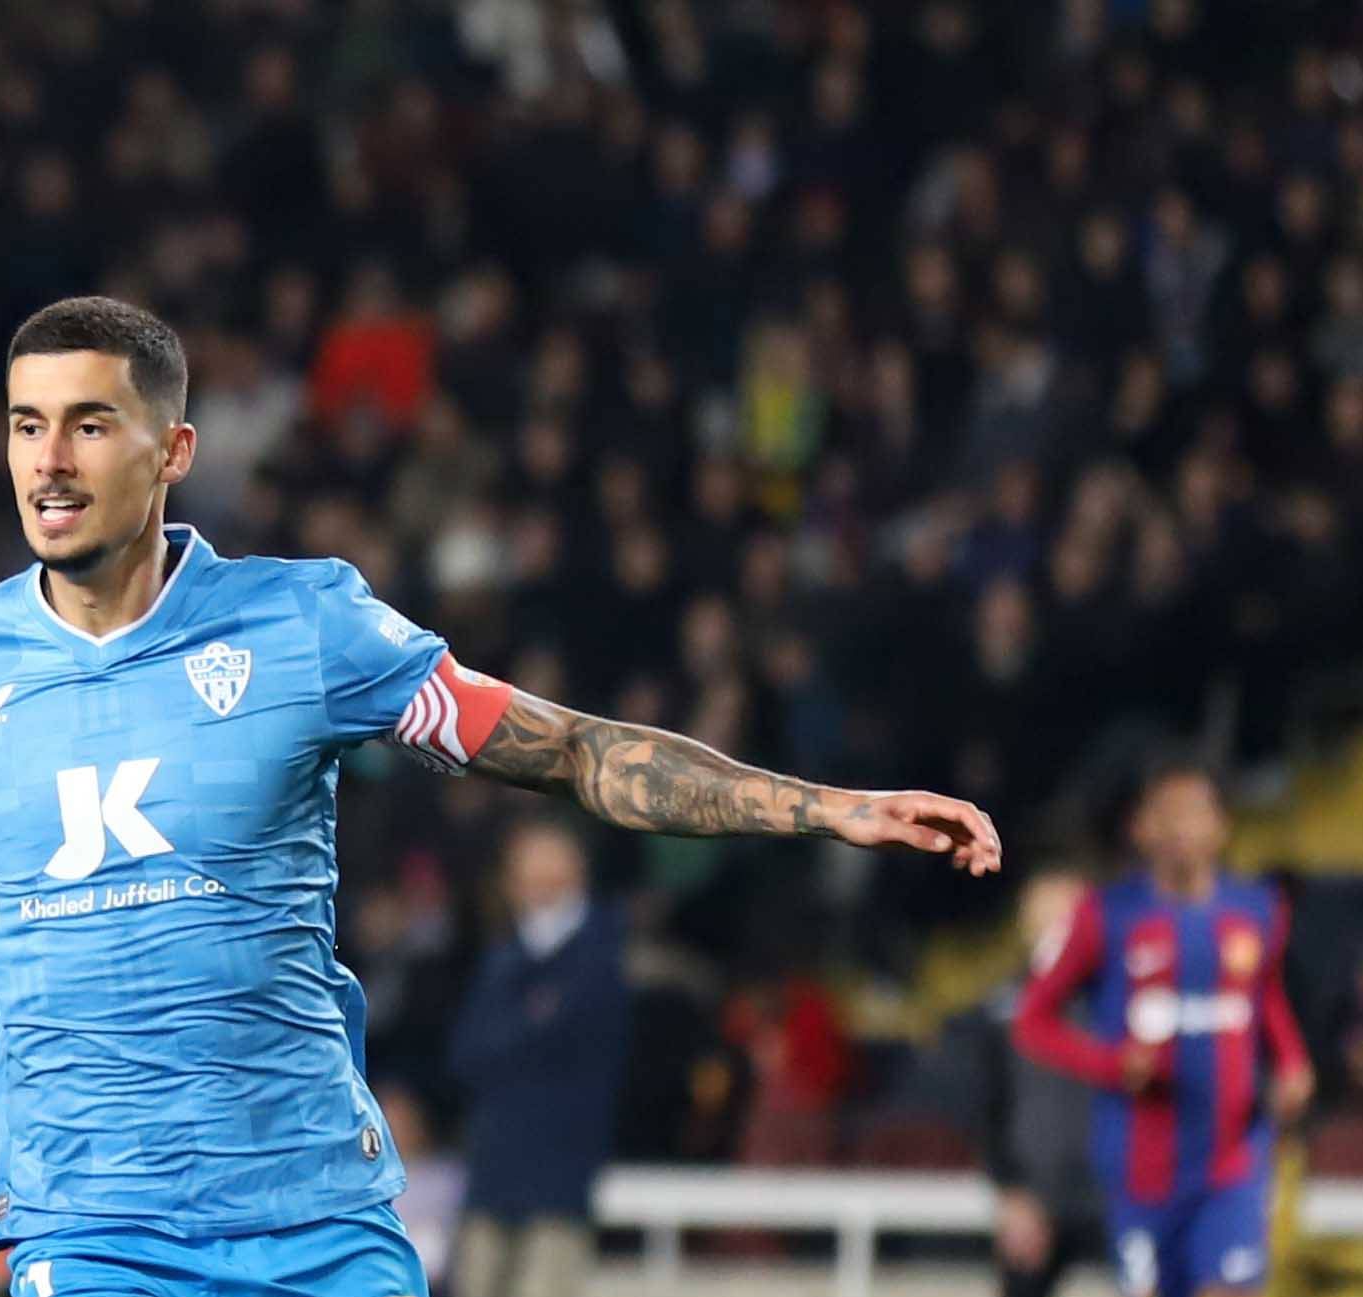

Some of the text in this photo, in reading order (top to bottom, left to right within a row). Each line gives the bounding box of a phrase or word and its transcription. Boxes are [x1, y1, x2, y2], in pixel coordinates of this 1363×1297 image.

[43, 757, 175, 881] JK
[20, 875, 227, 921] Khaled Juffali Co.
